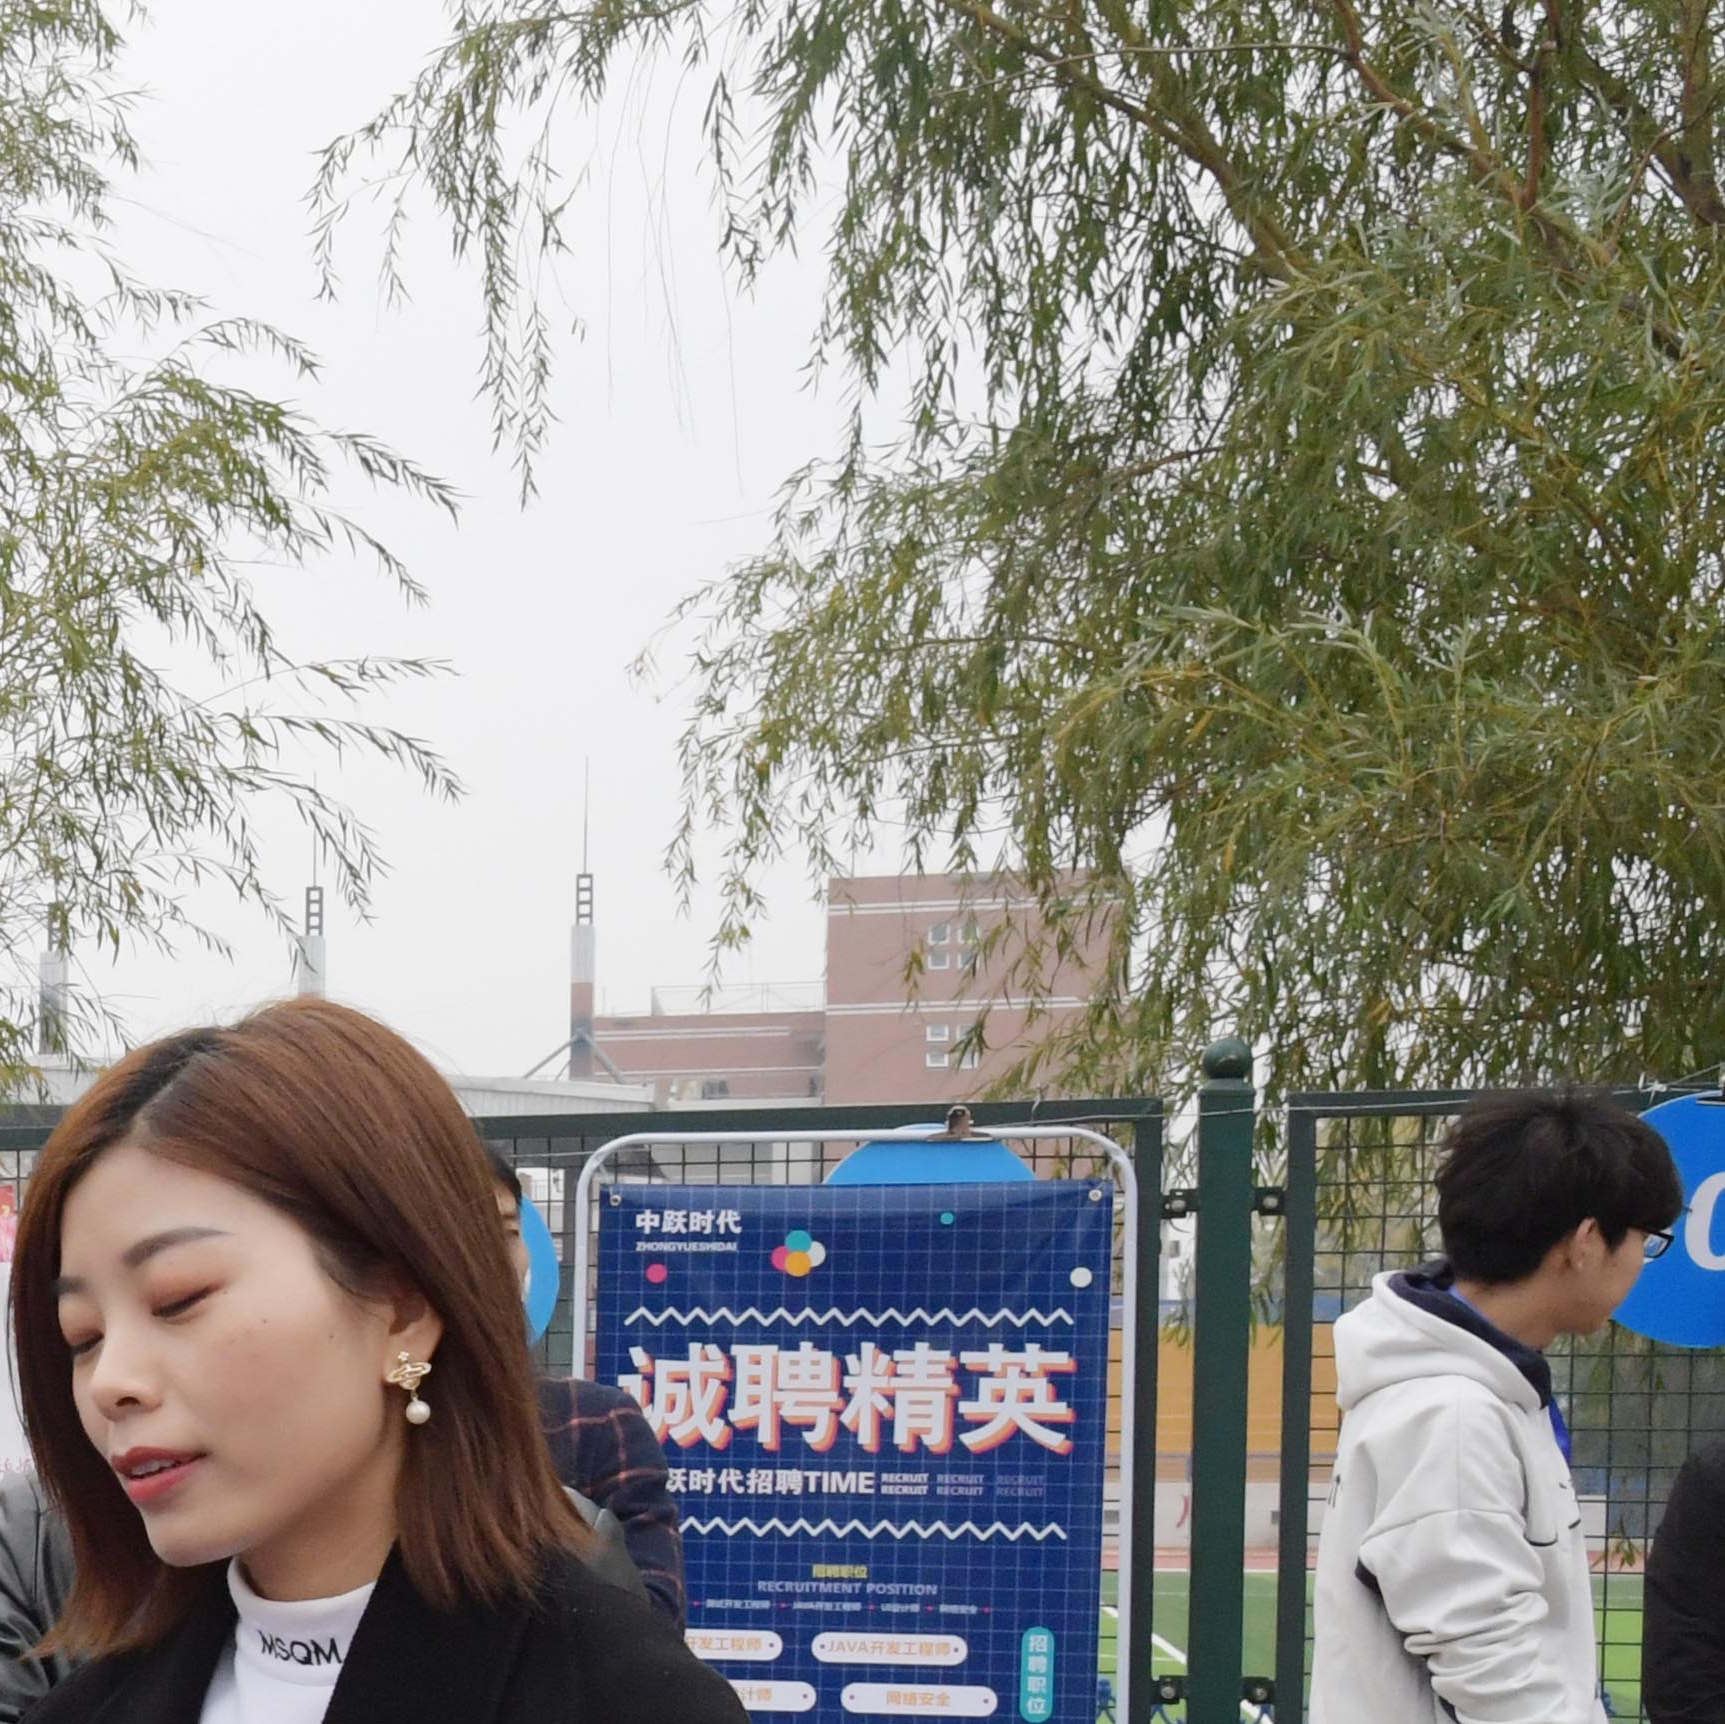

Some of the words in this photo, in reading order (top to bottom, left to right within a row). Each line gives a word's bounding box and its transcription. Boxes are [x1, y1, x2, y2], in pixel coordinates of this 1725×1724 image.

[635, 1209, 742, 1235] 中跃时代
[618, 1342, 1077, 1454] 诚聘精英
[881, 1473, 929, 1483] RECRUIT
[881, 1485, 929, 1495] RECRUIT
[757, 1580, 861, 1595] RECRUITMENT
[866, 1582, 938, 1597] POSITION
[827, 1640, 951, 1657] JAVA开发工程师
[1027, 1634, 1049, 1715] 招聘职位
[886, 1691, 951, 1708] 网络安全
